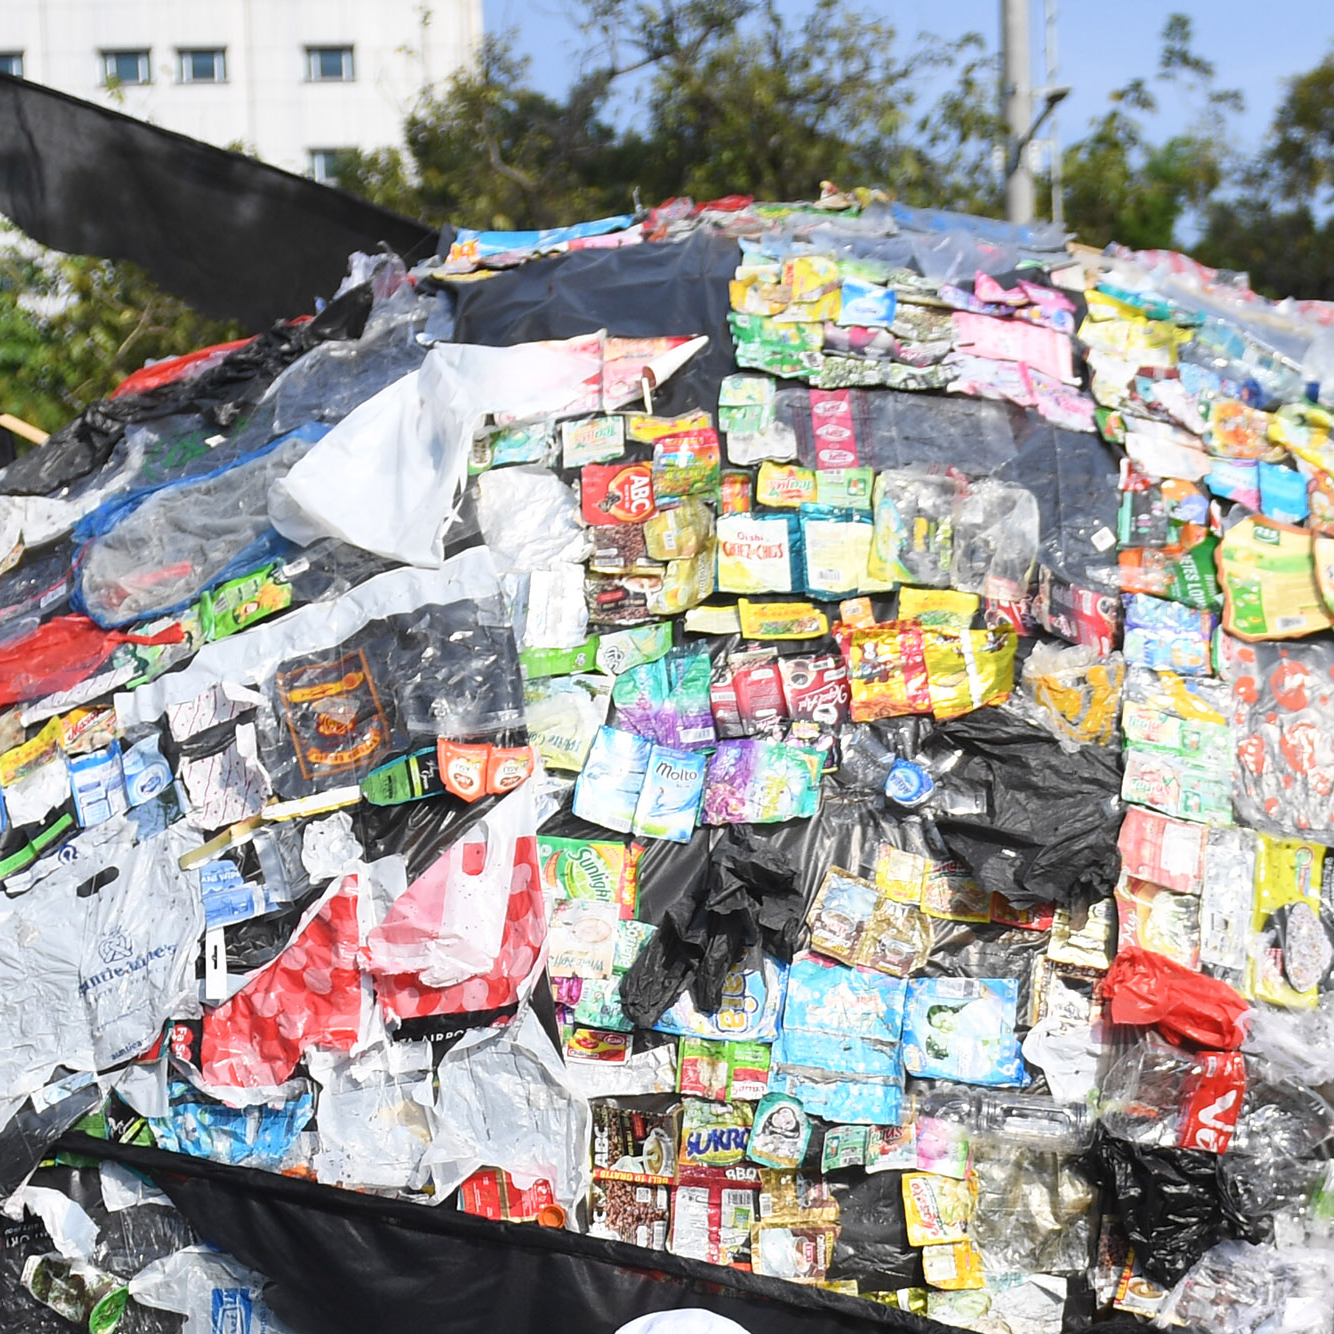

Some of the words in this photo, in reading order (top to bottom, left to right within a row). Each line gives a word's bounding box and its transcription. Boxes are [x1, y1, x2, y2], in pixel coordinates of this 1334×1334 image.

[627, 474, 651, 512] ABC
[653, 760, 698, 782] Molto
[592, 1125, 608, 1167] ABC
[724, 1166, 757, 1182] BBQ
